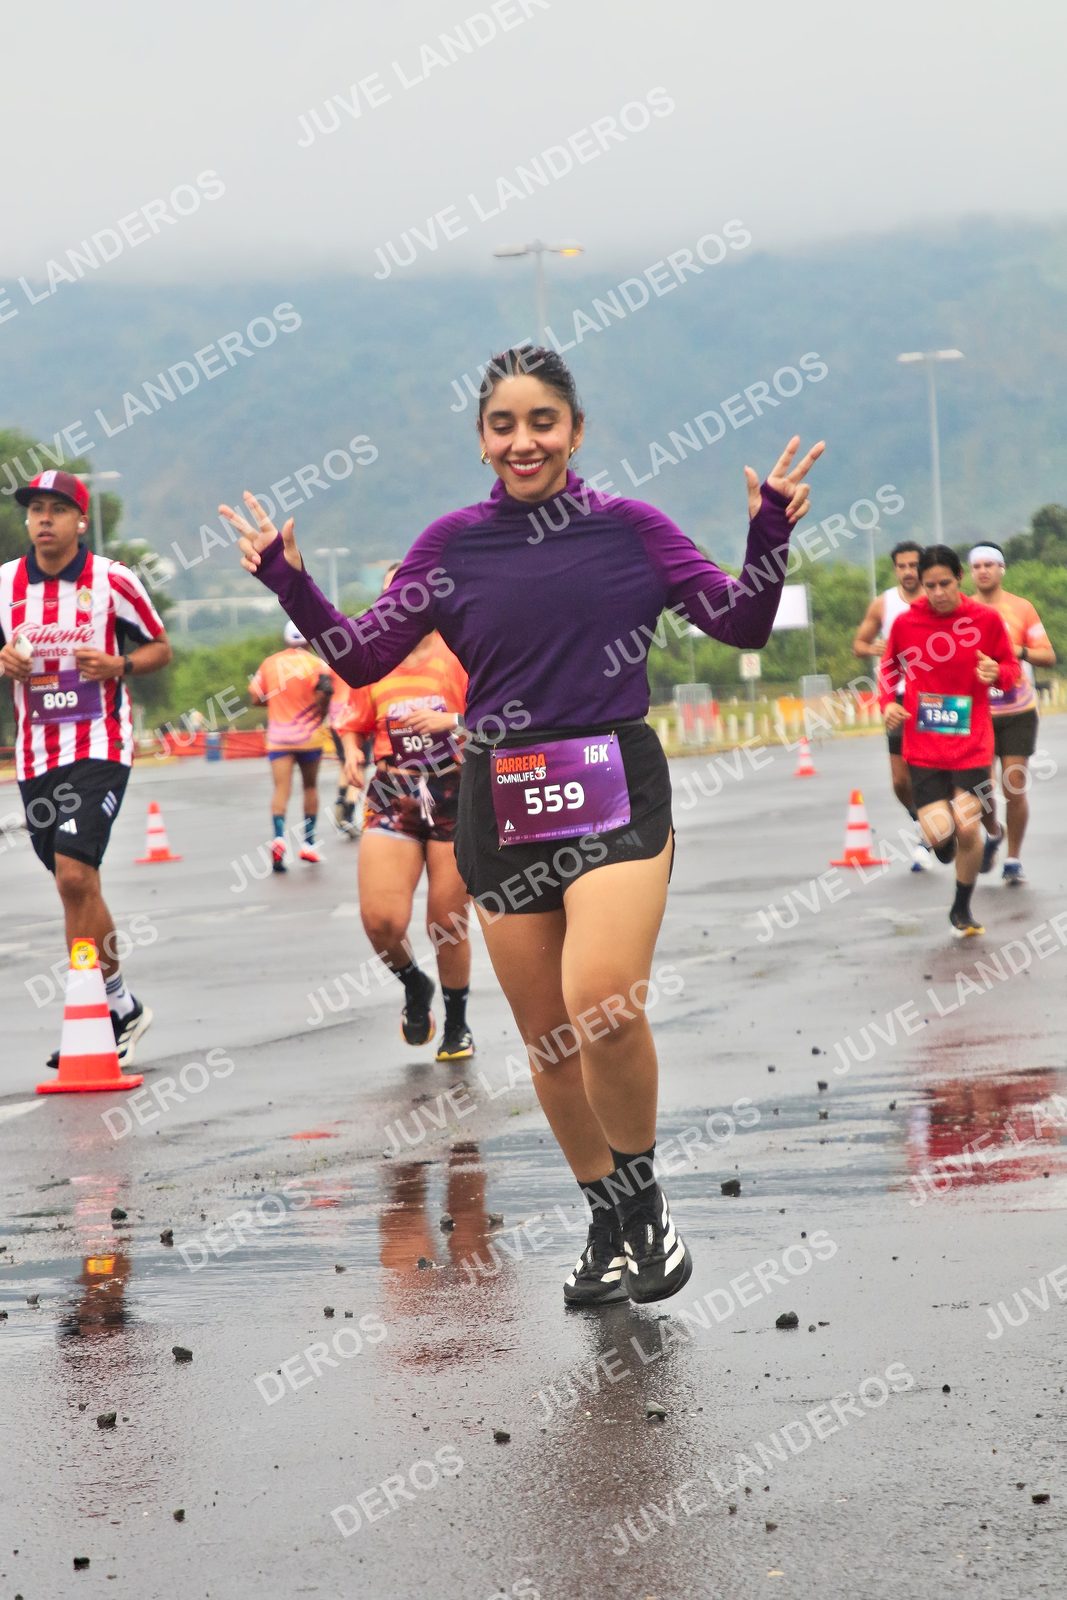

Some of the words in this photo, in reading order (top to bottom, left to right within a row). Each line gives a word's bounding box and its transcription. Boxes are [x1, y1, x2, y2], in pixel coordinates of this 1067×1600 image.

[43, 691, 78, 709] 809
[402, 733, 434, 752] 505
[496, 753, 546, 774] CARRERA
[524, 782, 585, 815] 559
